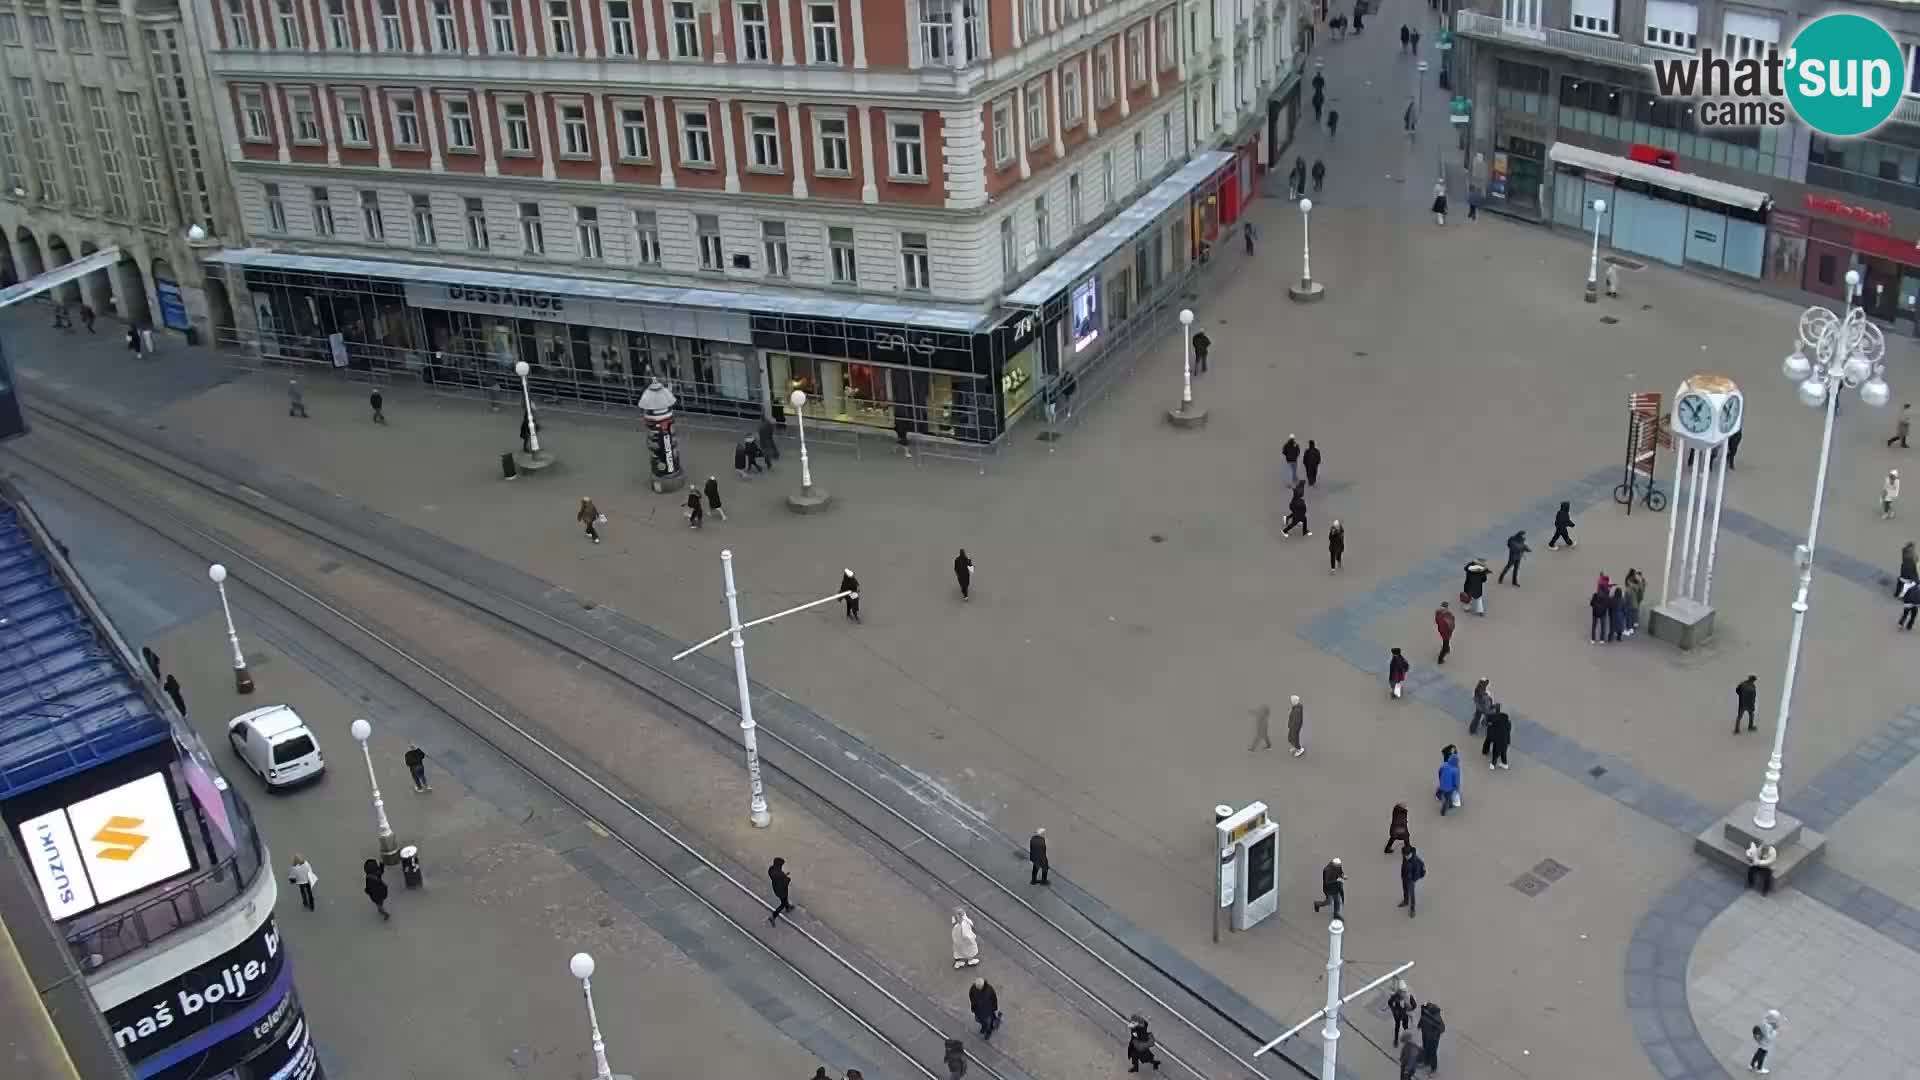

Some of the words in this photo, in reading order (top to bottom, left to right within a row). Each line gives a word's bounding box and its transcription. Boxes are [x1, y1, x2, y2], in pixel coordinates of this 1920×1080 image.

[37, 824, 75, 904] SUZUKI
[114, 1000, 174, 1049] naš
[177, 959, 267, 1017] bolje,
